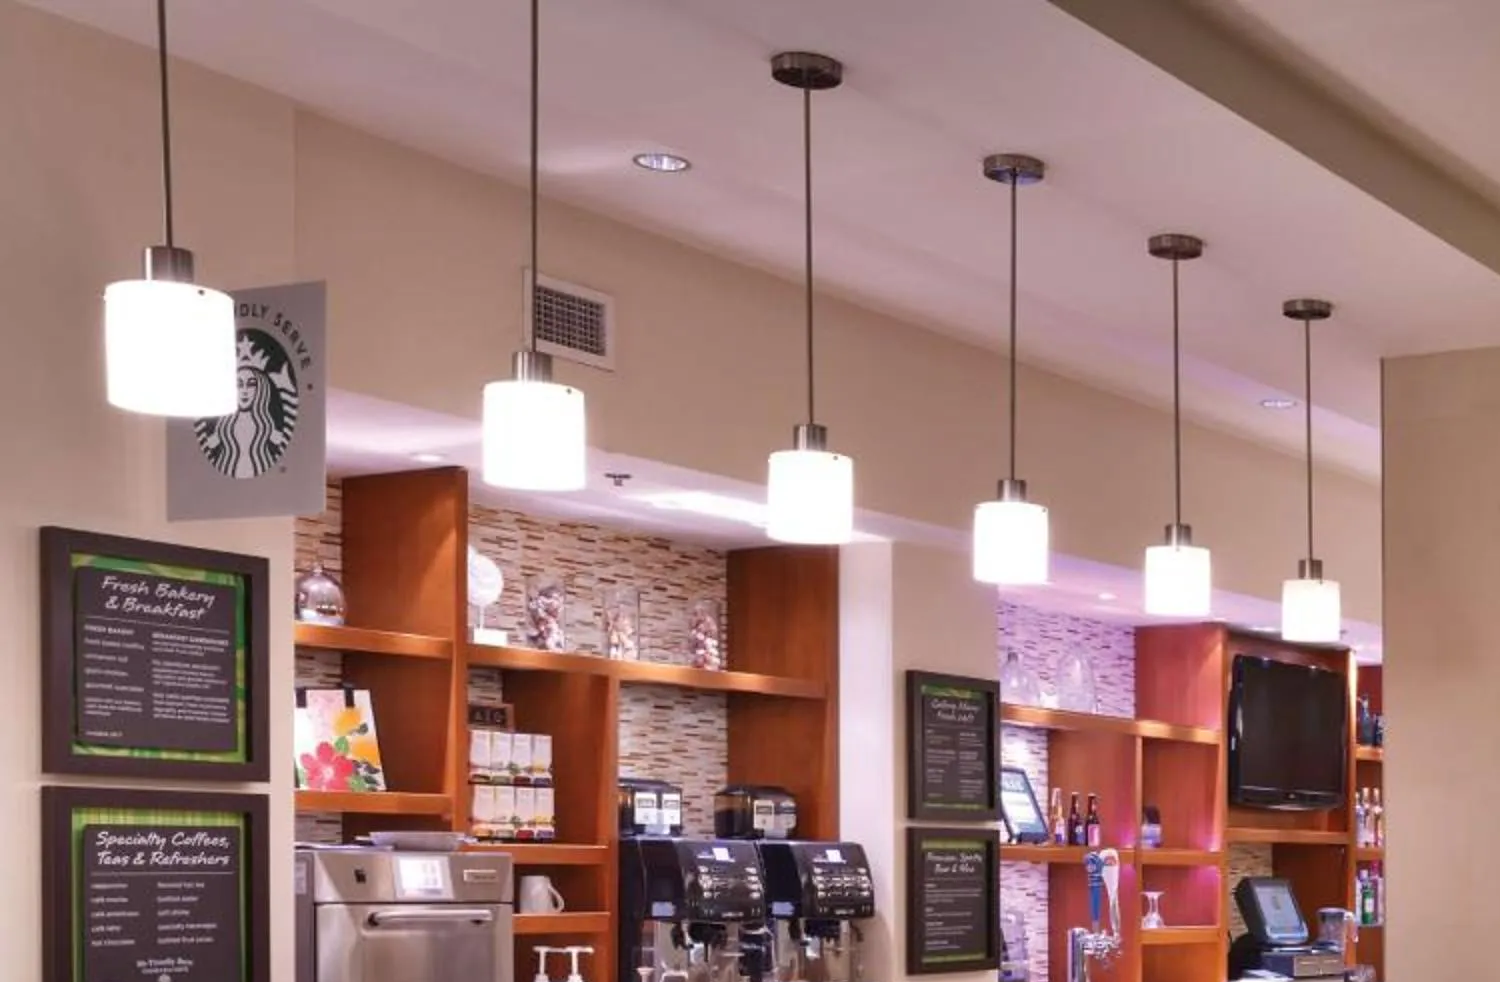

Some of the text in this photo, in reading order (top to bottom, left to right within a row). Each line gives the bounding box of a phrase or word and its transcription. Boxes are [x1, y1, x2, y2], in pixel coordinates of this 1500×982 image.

[273, 312, 311, 370] SERVE
[102, 576, 216, 609] Fresh Bakery
[105, 596, 207, 619] & Breakfast
[96, 831, 230, 850] Specialty Coffees,
[97, 851, 231, 867] Teas & Refreshers
